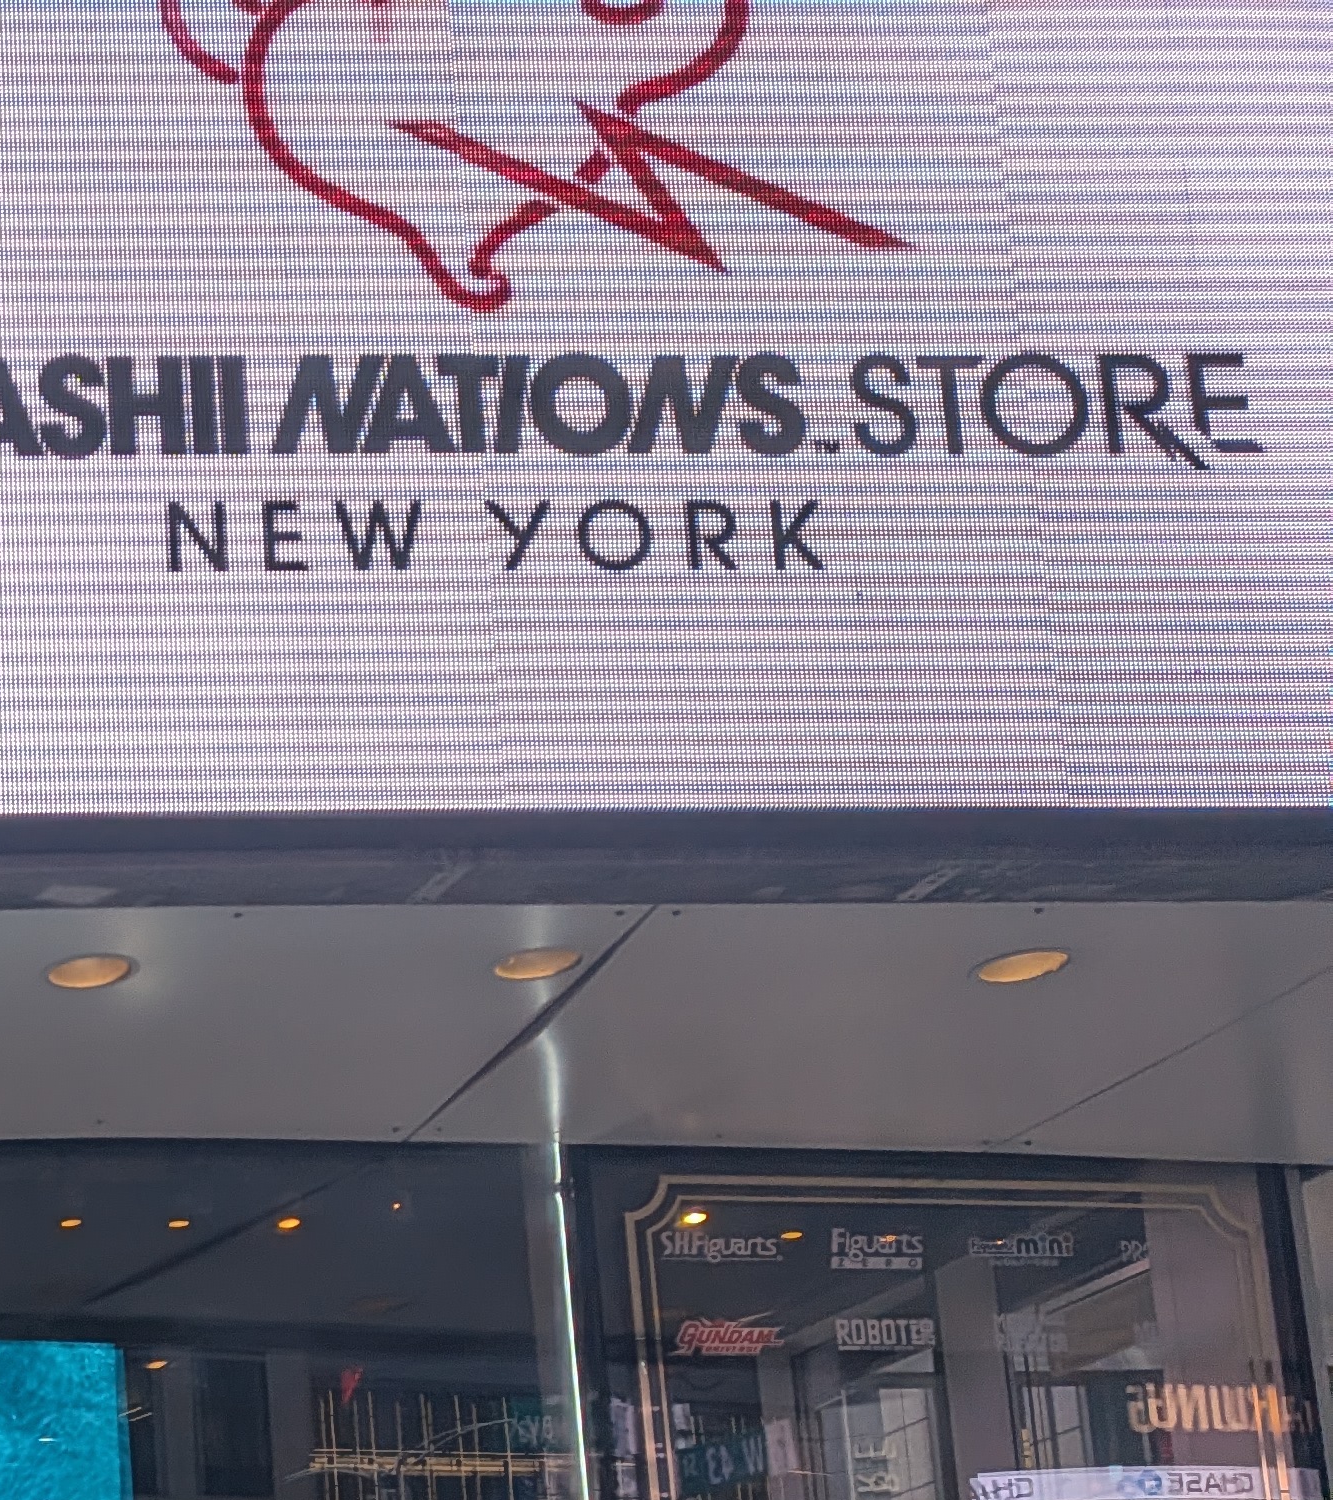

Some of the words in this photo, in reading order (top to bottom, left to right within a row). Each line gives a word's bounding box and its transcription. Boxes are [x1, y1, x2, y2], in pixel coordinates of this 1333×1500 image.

[852, 350, 1264, 470] STORE
[166, 501, 424, 572] NEW
[487, 499, 827, 572] YORK
[831, 1227, 924, 1261] Figuarts
[835, 1257, 921, 1269] ZERO
[676, 1319, 777, 1352] GUNDAM
